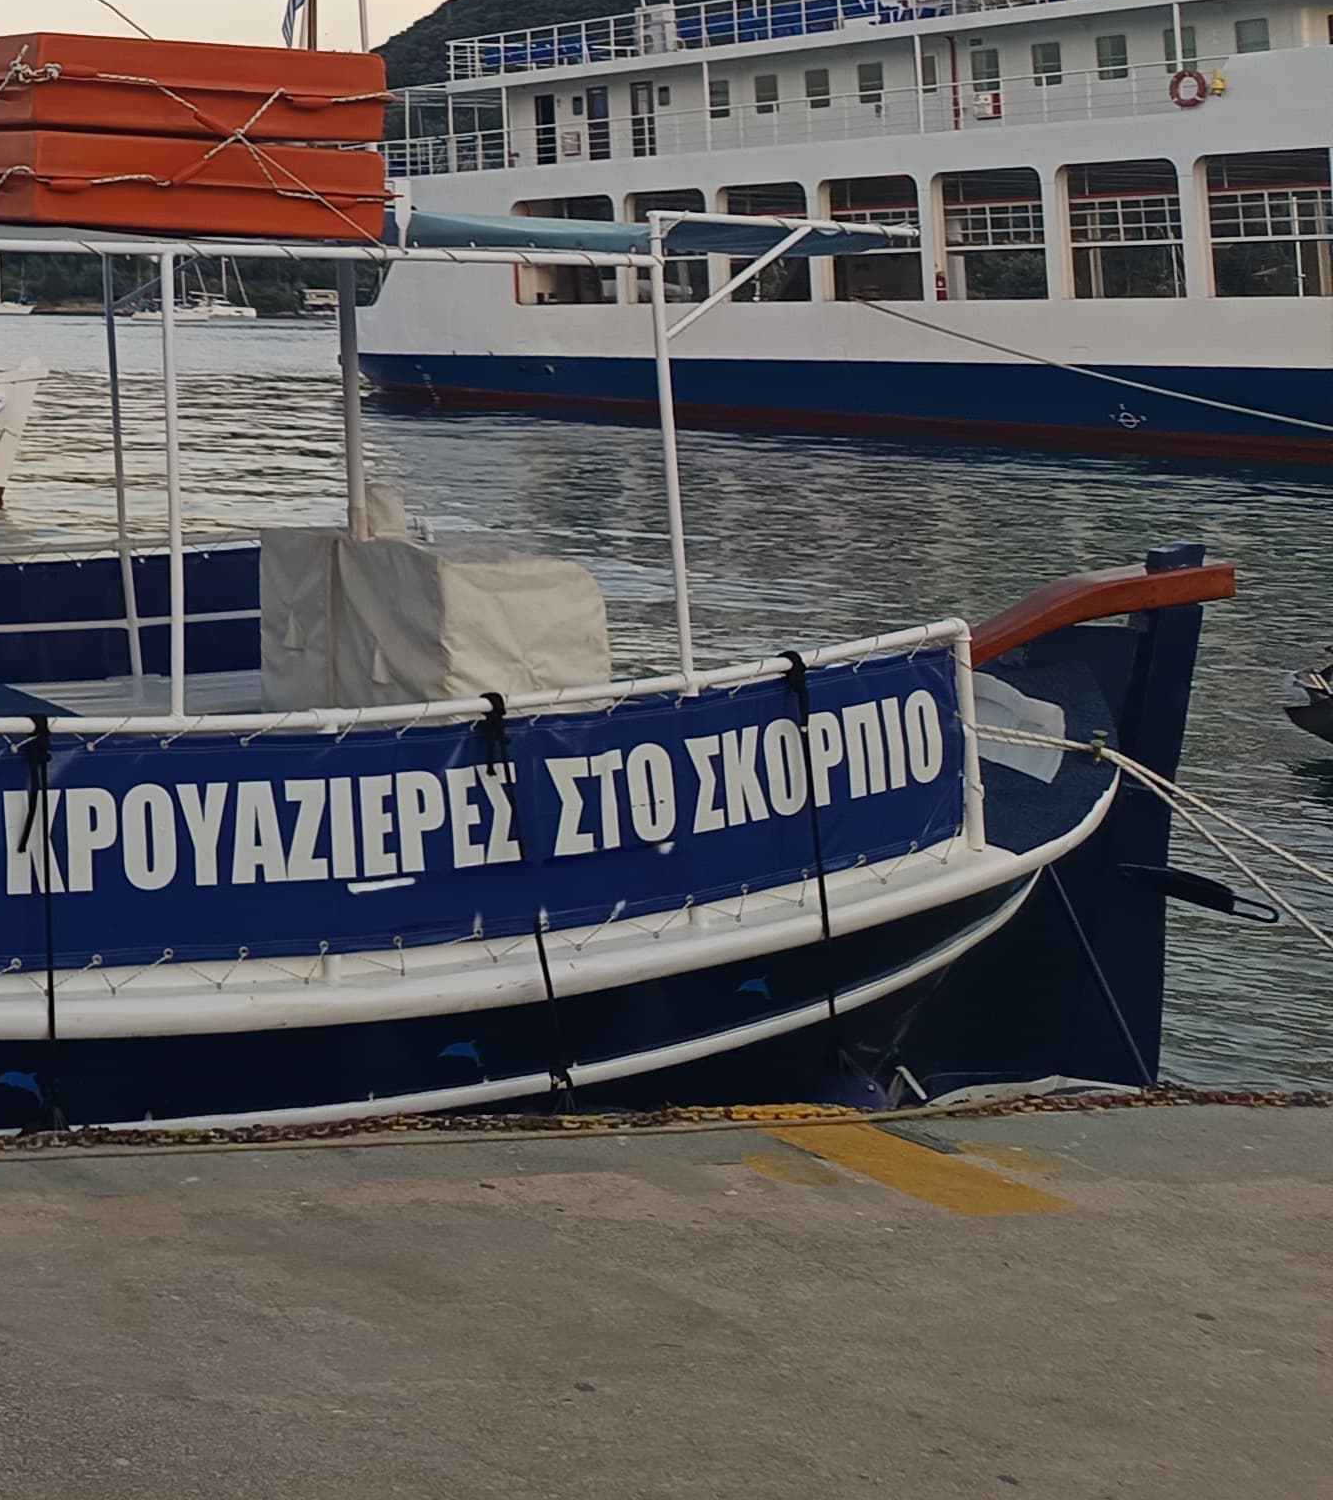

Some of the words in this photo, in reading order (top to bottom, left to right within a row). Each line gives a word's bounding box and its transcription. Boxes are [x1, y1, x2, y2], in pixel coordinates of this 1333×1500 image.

[2, 761, 523, 896] ΚΡΟΥΑΖΙΕΡΕΣ
[545, 742, 677, 857] ΣΤΟ
[684, 688, 944, 834] ΣΚΟΡΠΙΟ
